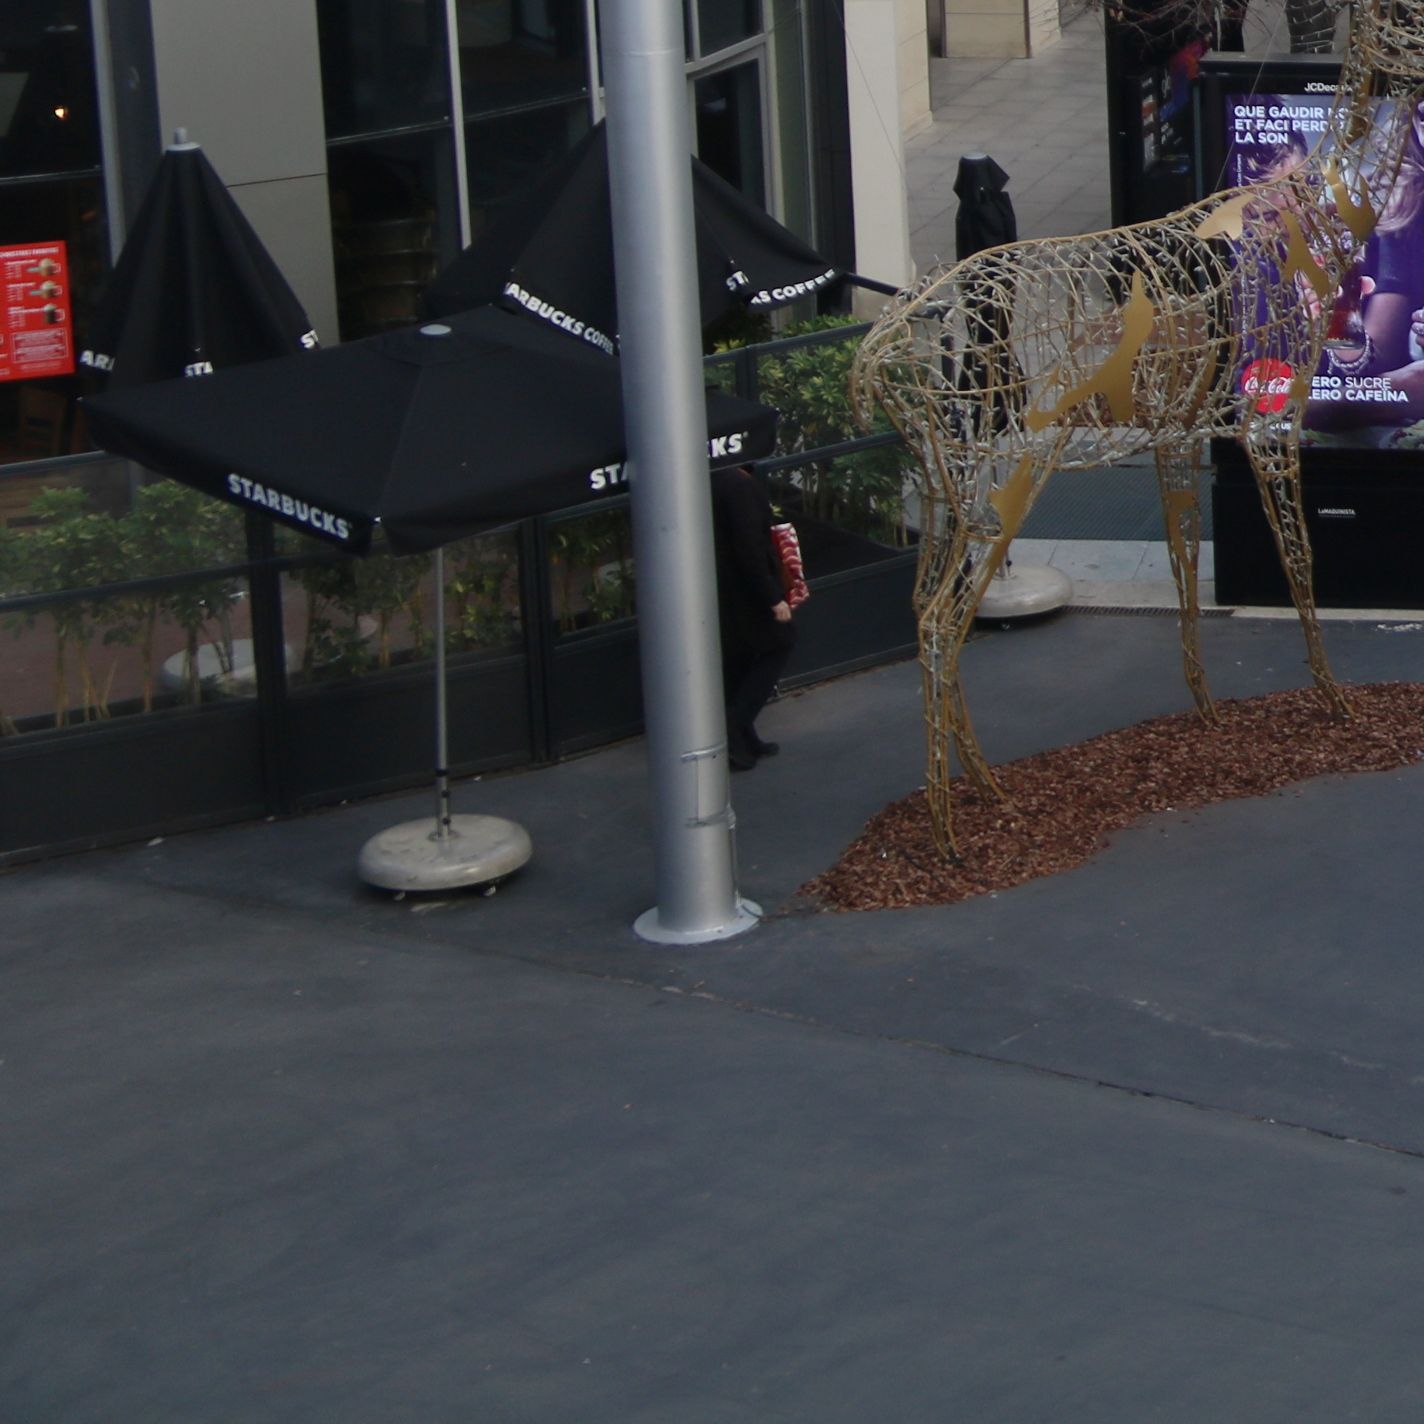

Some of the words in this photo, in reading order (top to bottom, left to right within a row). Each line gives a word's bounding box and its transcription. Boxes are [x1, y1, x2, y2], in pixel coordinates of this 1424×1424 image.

[1234, 105, 1266, 118] QUE
[1268, 106, 1324, 119] GAUDIR
[1234, 118, 1253, 130] ET
[1256, 119, 1289, 131] FACI
[1291, 120, 1344, 132] PERD
[1235, 132, 1255, 144] LA
[1257, 132, 1289, 144] SON
[504, 280, 585, 336] ARBUCKS
[1311, 376, 1342, 388] ERO
[1345, 377, 1392, 389] SUCRE
[1308, 389, 1342, 401] ERO
[227, 472, 353, 541] STARBUCKS
